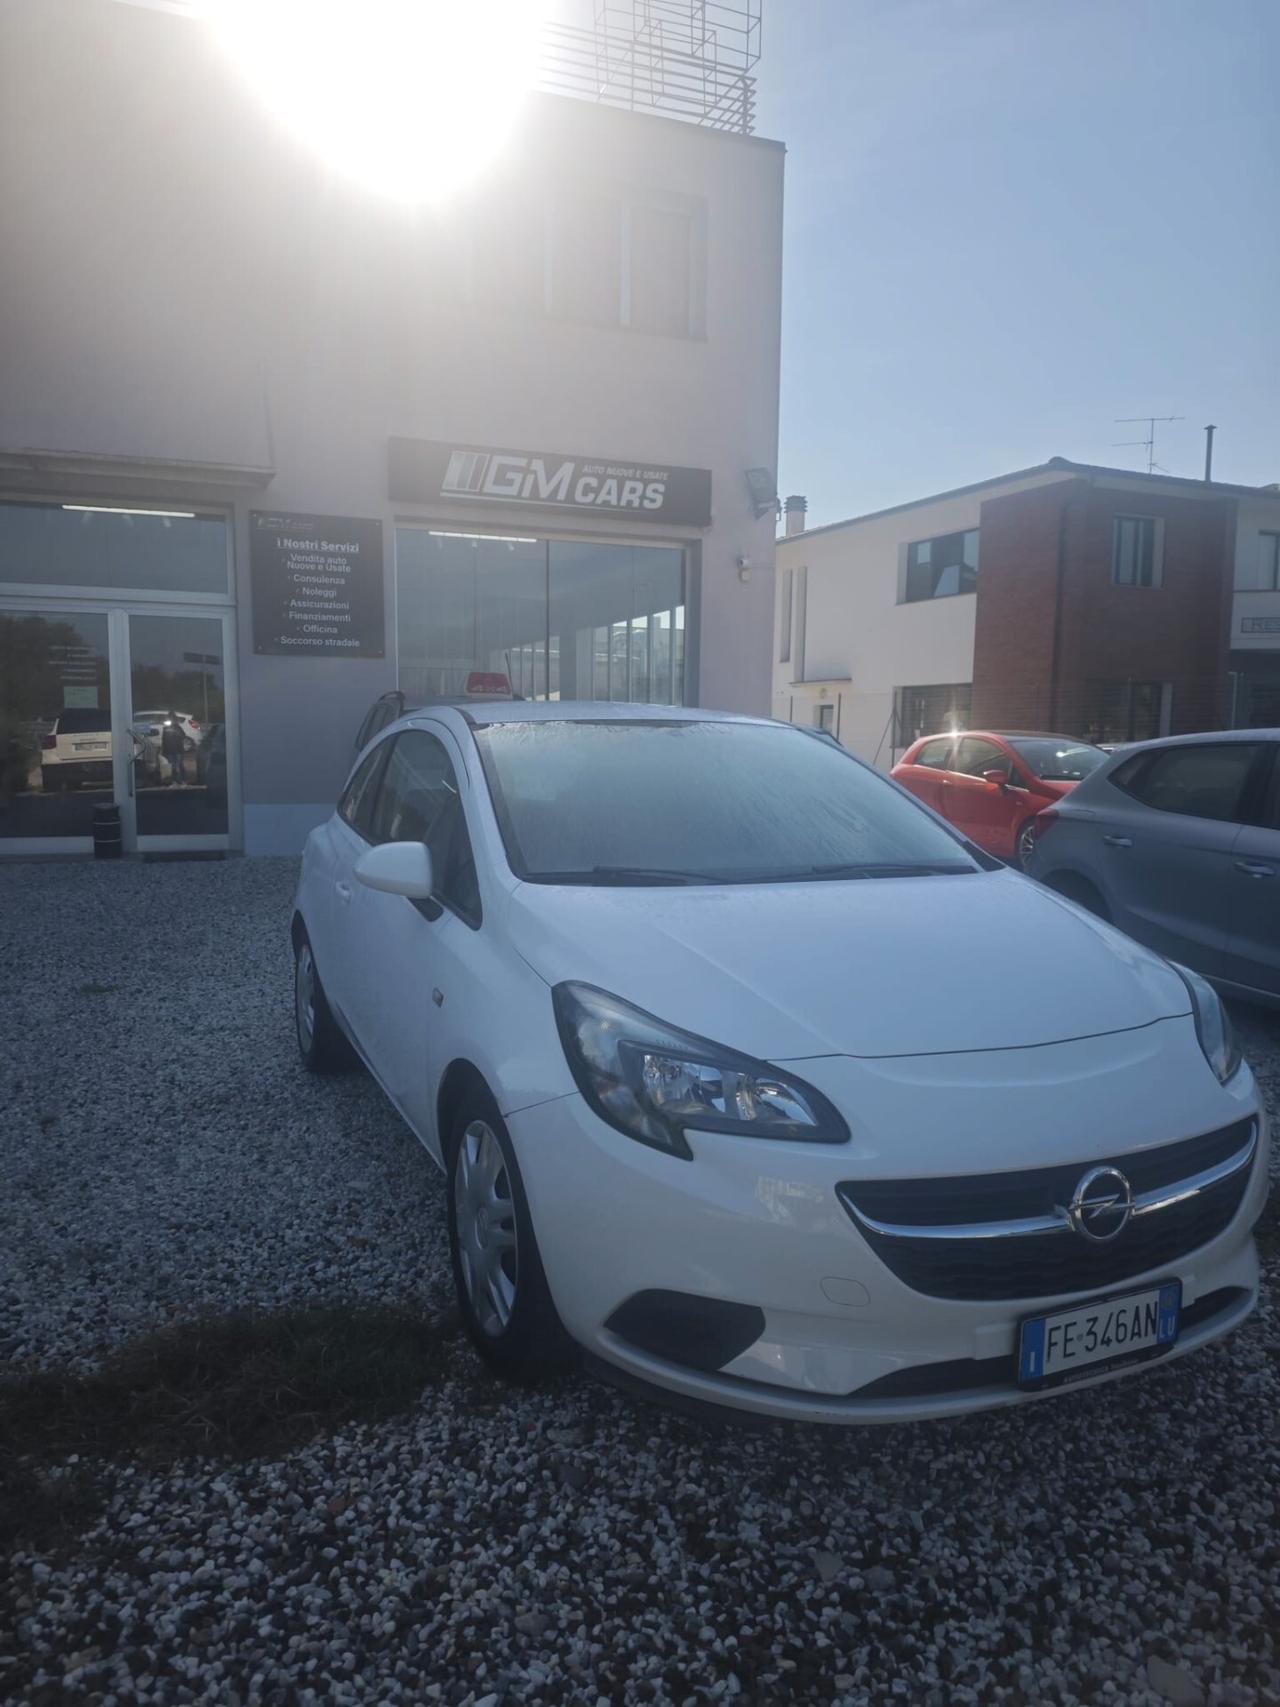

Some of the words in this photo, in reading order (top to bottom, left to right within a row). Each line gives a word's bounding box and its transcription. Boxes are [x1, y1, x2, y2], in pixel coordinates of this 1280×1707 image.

[582, 464, 606, 476] AUTO
[574, 476, 666, 510] CARS
[283, 539, 318, 550] Nostri
[320, 541, 360, 553] Servizi
[291, 553, 325, 563] Vendita
[327, 556, 347, 565] auto
[287, 561, 316, 570] Nuove
[326, 563, 351, 573] Usate
[293, 574, 346, 585] Consulenza
[302, 587, 337, 598] Noleggi
[290, 599, 350, 609] Assicurazioni
[289, 611, 351, 622] Finanziamenti
[303, 624, 338, 633] Officina
[280, 636, 323, 646] Soccorso
[324, 638, 361, 648] stradale
